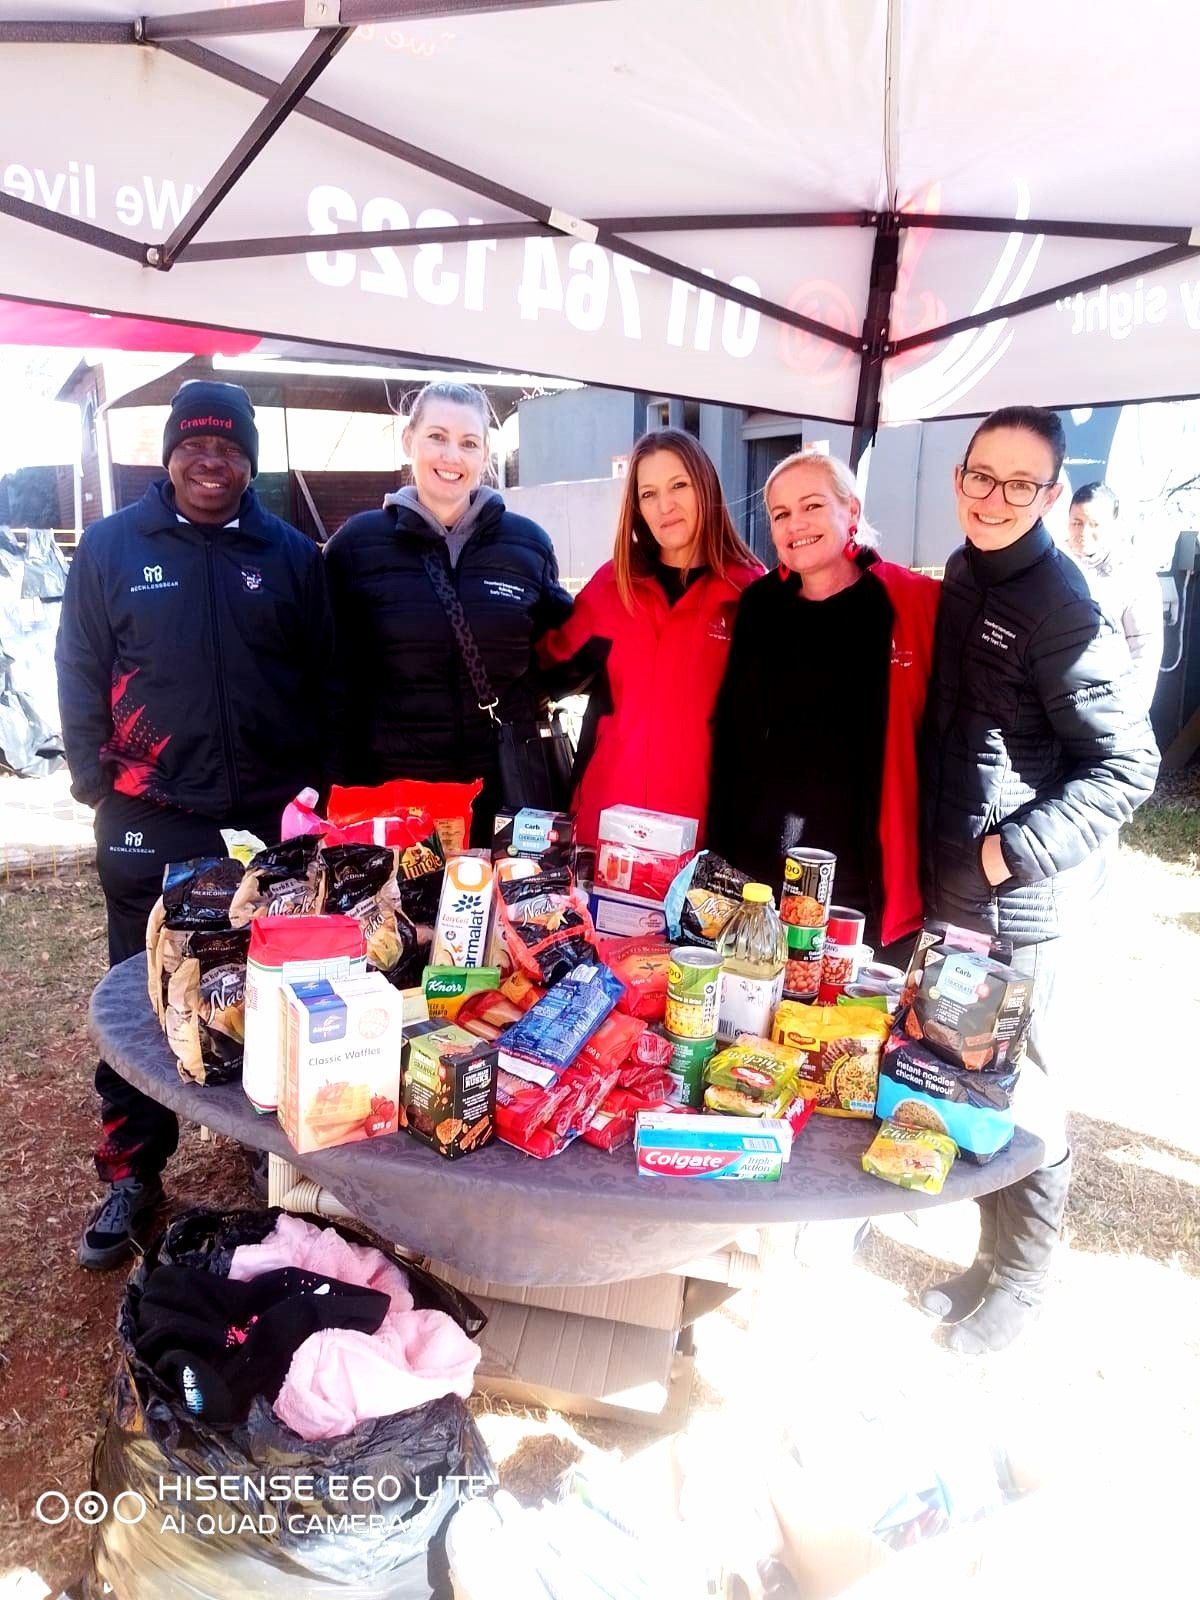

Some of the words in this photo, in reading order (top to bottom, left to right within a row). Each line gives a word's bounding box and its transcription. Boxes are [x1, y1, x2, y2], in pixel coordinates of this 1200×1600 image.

[180, 415, 233, 430] Crawford
[399, 854, 443, 880] Jungle
[786, 863, 800, 875] OO
[464, 909, 485, 968] armalat
[667, 968, 681, 980] OO
[955, 966, 972, 978] Carb
[427, 980, 464, 993] Knorr
[308, 1054, 342, 1067] Classic
[344, 1047, 381, 1060] Waffles
[896, 1059, 922, 1076] instant
[922, 1070, 956, 1087] noodles
[465, 1074, 489, 1088] RUSKS
[895, 1069, 924, 1086] chicken
[924, 1079, 955, 1096] flavour
[645, 1150, 723, 1169] Colgate
[740, 1163, 771, 1173] Action
